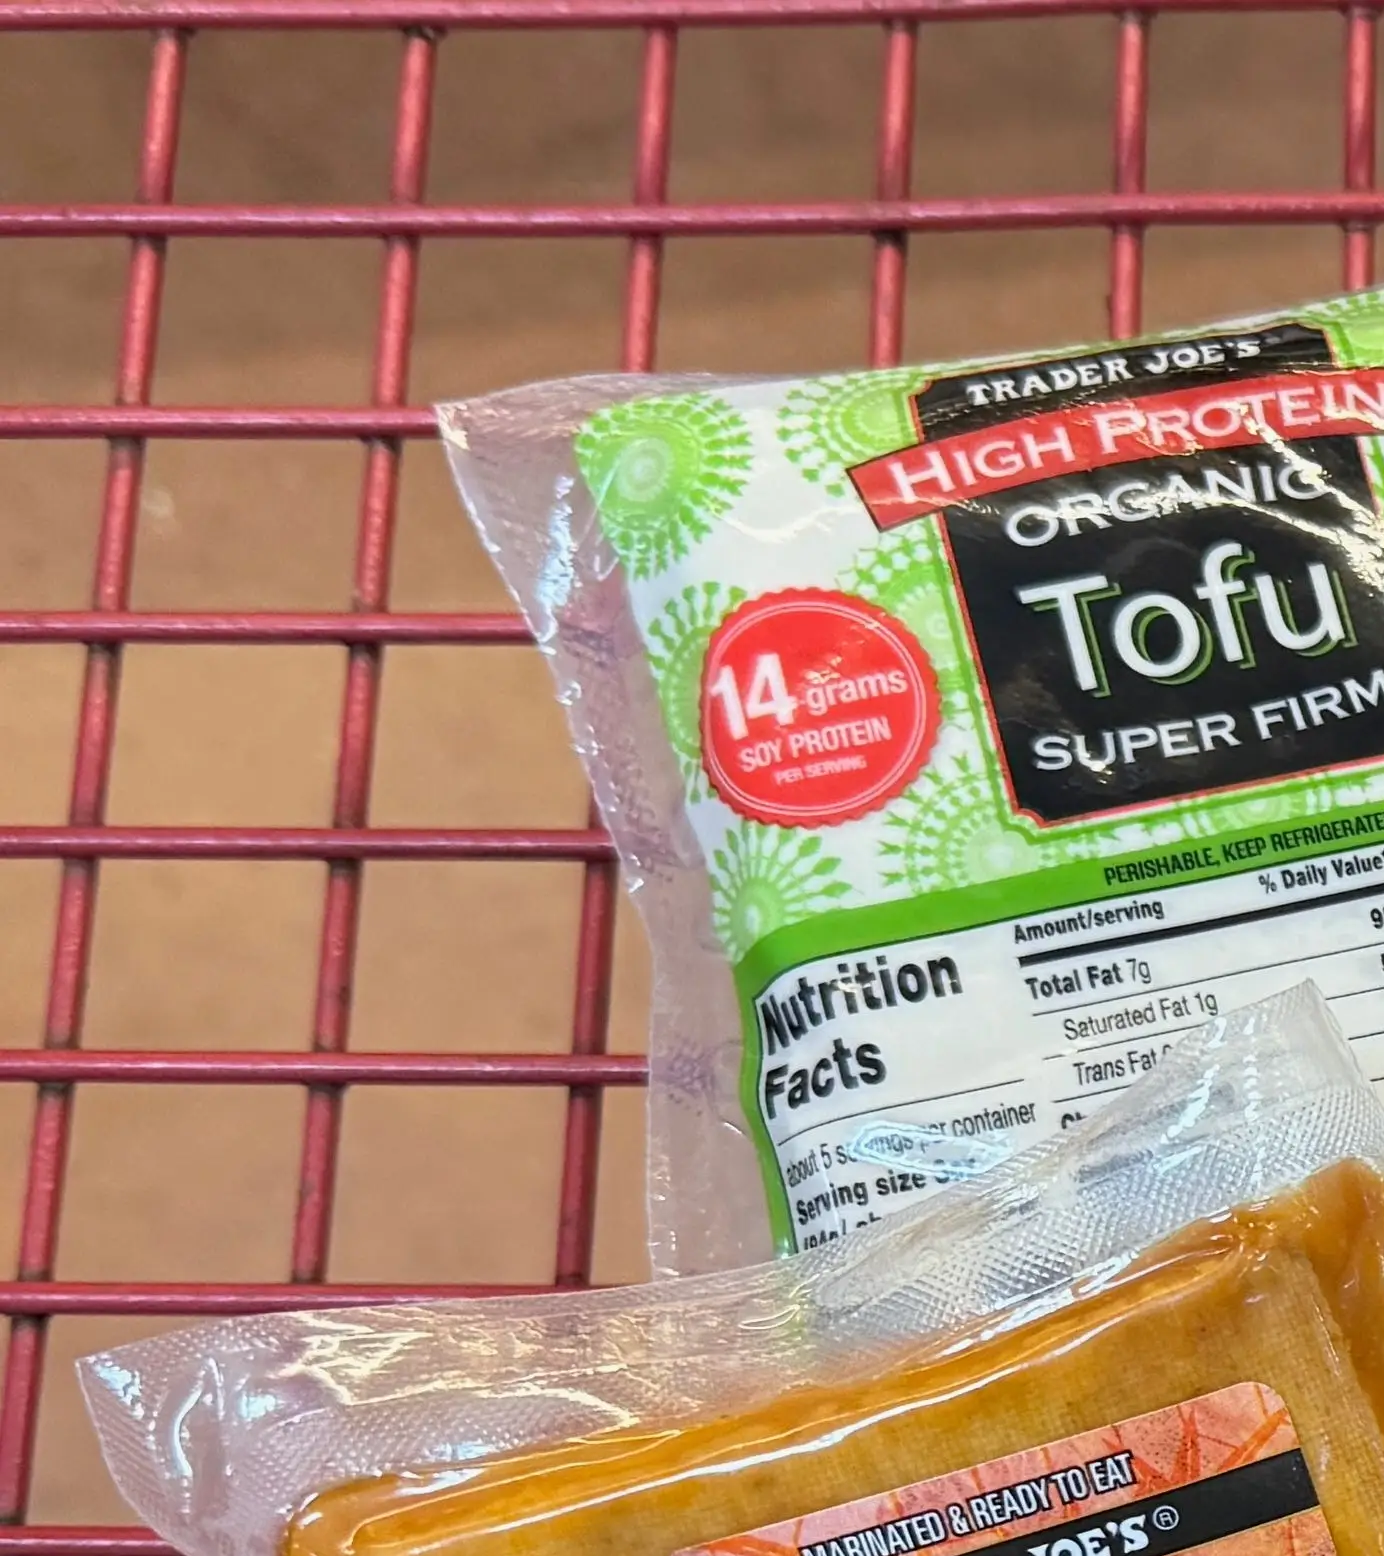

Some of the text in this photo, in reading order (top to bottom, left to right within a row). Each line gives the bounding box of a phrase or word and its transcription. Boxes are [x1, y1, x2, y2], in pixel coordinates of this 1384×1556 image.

[966, 350, 1142, 407] TRADER
[889, 426, 1075, 503] HIGH
[1005, 462, 1330, 546] ORGANIC
[1018, 541, 1345, 692] Tofu
[710, 652, 908, 741] 14 grams
[740, 717, 892, 773] SOY PROTEIN
[1032, 712, 1241, 772] SUPER
[1104, 851, 1221, 886] PERISHABLE,
[1221, 838, 1267, 863] KEEP
[1259, 874, 1278, 894] %
[1282, 865, 1329, 891] Daily
[1013, 900, 1165, 944] Amount/serving
[759, 954, 964, 1056] Nutrition
[1026, 970, 1082, 1001] Total
[1087, 961, 1125, 988] Fat
[1128, 959, 1152, 985] 7g
[764, 1038, 887, 1120] Facts
[948, 1505, 971, 1535] &
[971, 1477, 1052, 1530] READY
[1054, 1466, 1089, 1504] TO
[1088, 1451, 1135, 1494] EAT
